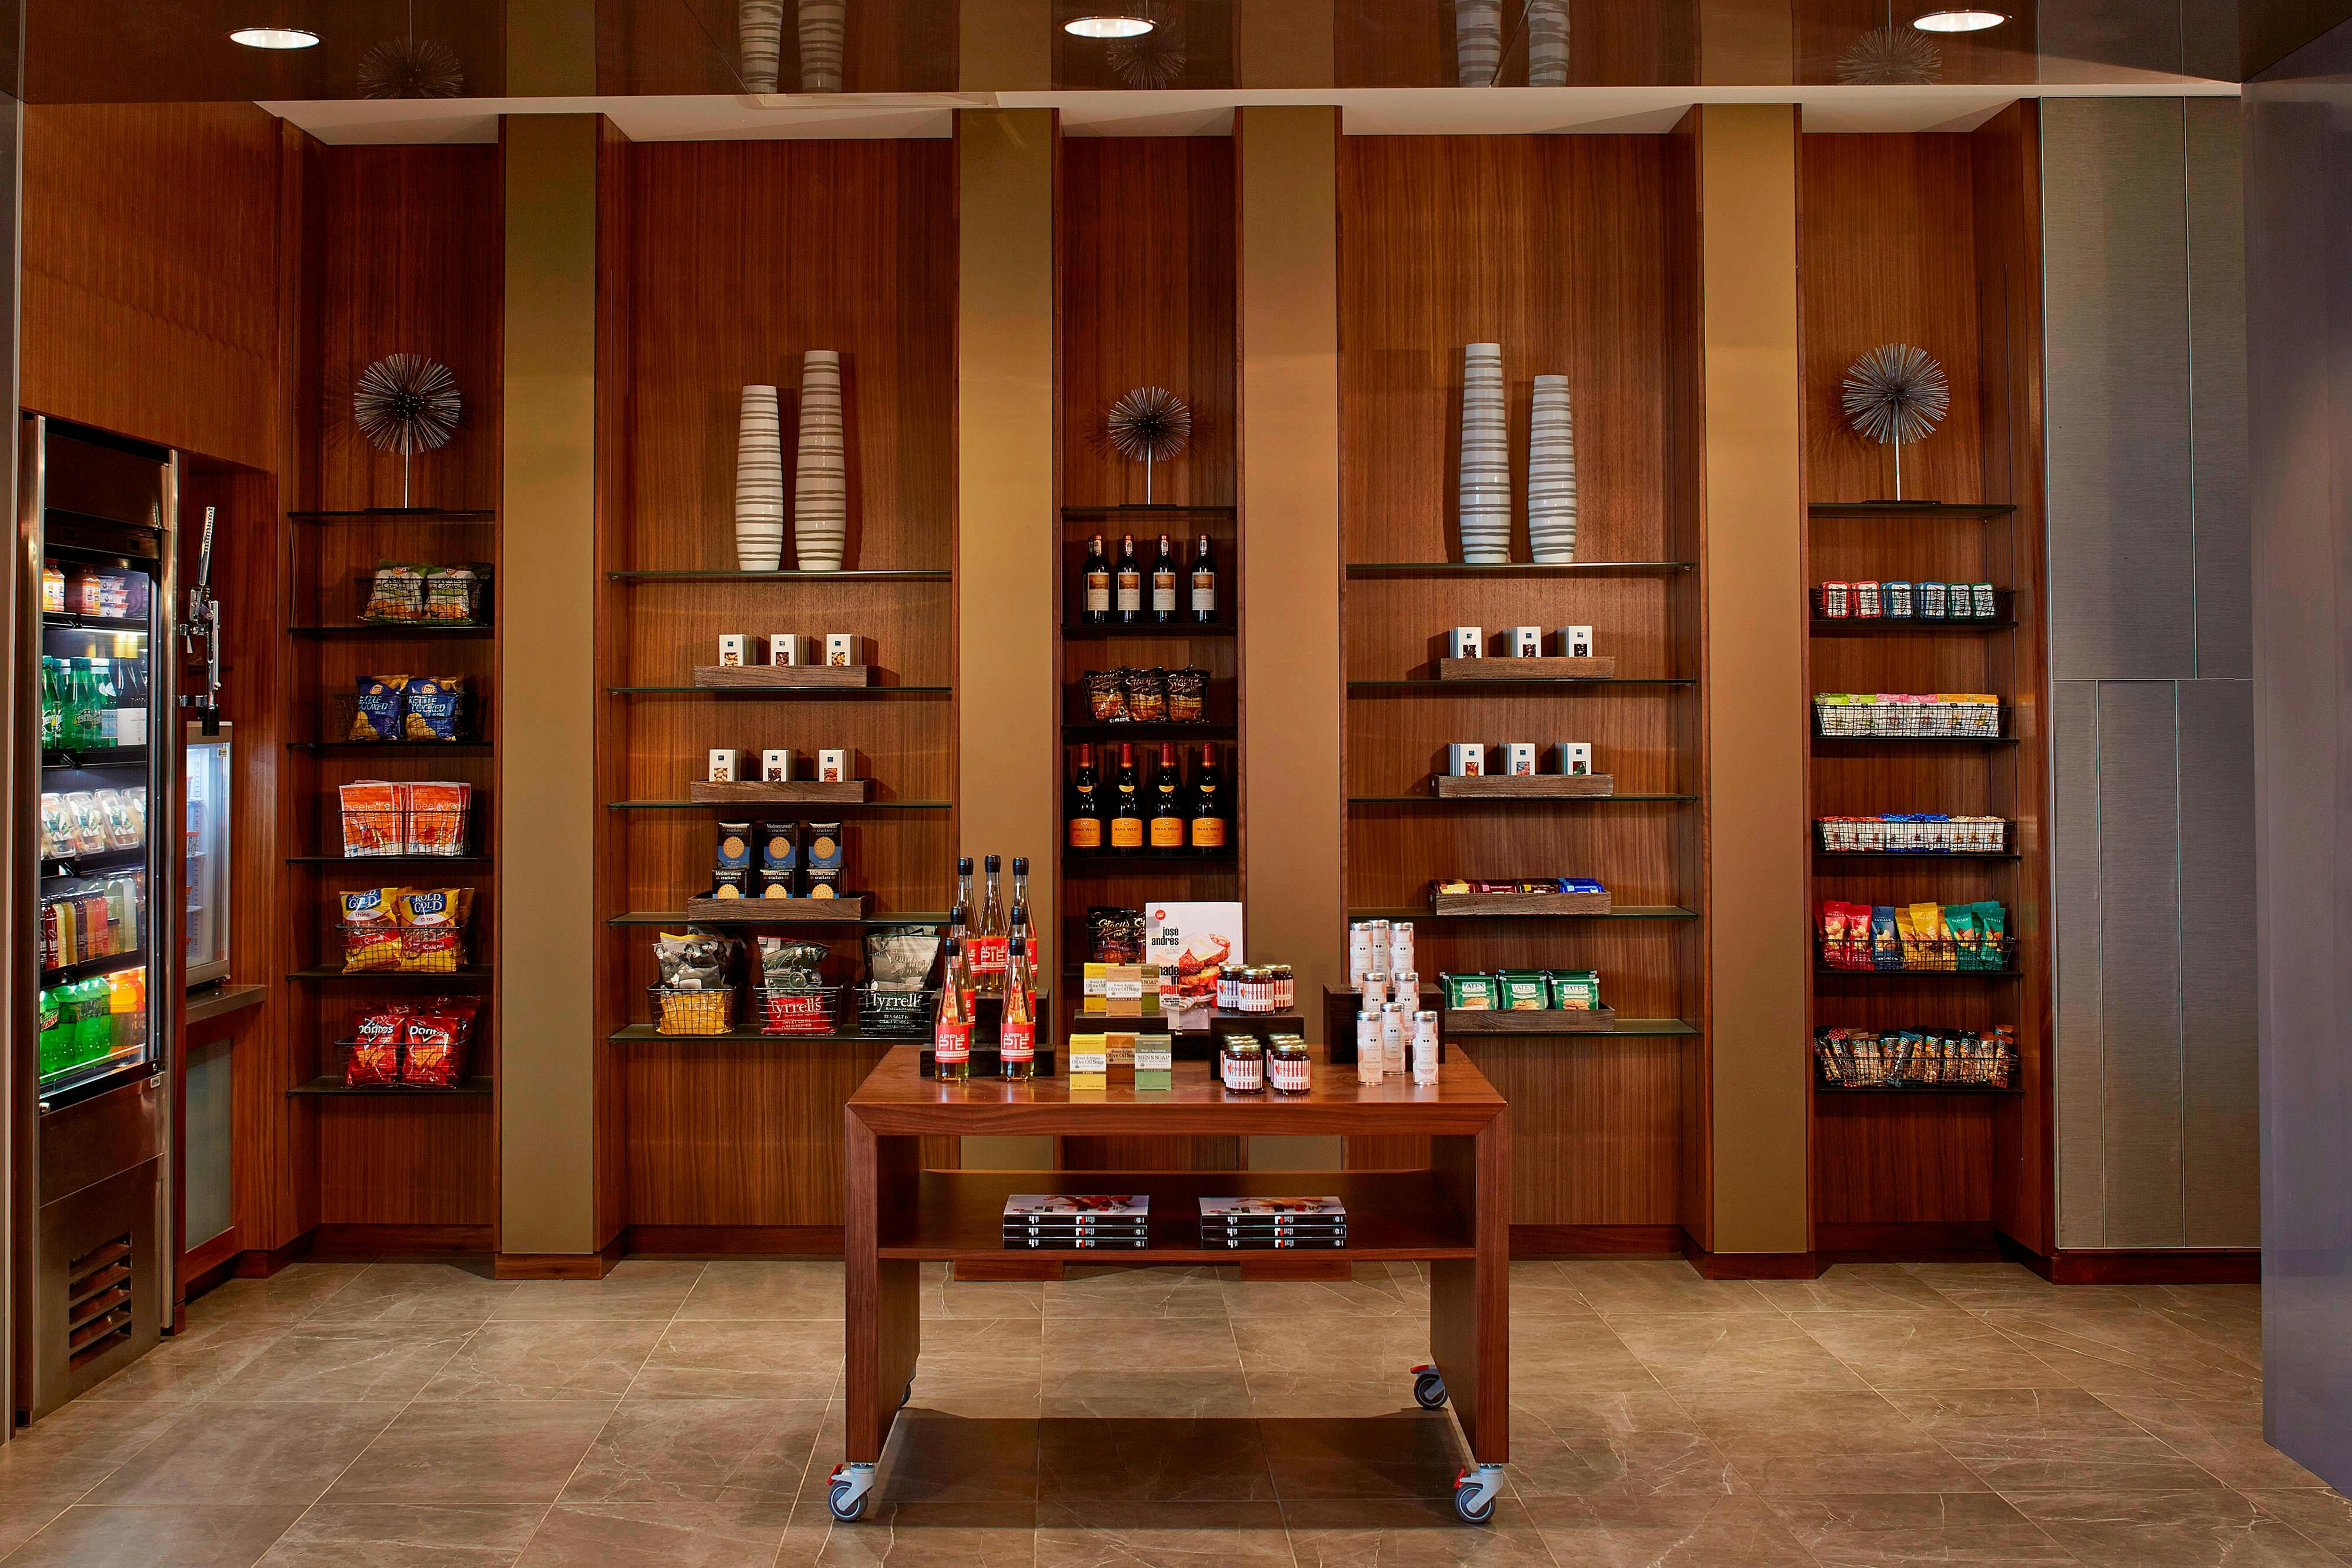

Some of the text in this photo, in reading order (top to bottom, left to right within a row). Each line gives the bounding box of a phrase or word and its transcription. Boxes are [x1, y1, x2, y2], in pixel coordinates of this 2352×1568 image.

[414, 901, 442, 912] GOLD
[1162, 926, 1178, 937] josé
[1151, 936, 1179, 945] andrés
[981, 951, 1005, 961] PIE
[1171, 975, 1179, 985] in
[1160, 984, 1180, 995] pain
[938, 1039, 965, 1051] PIE
[1003, 1038, 1030, 1049] PIE
